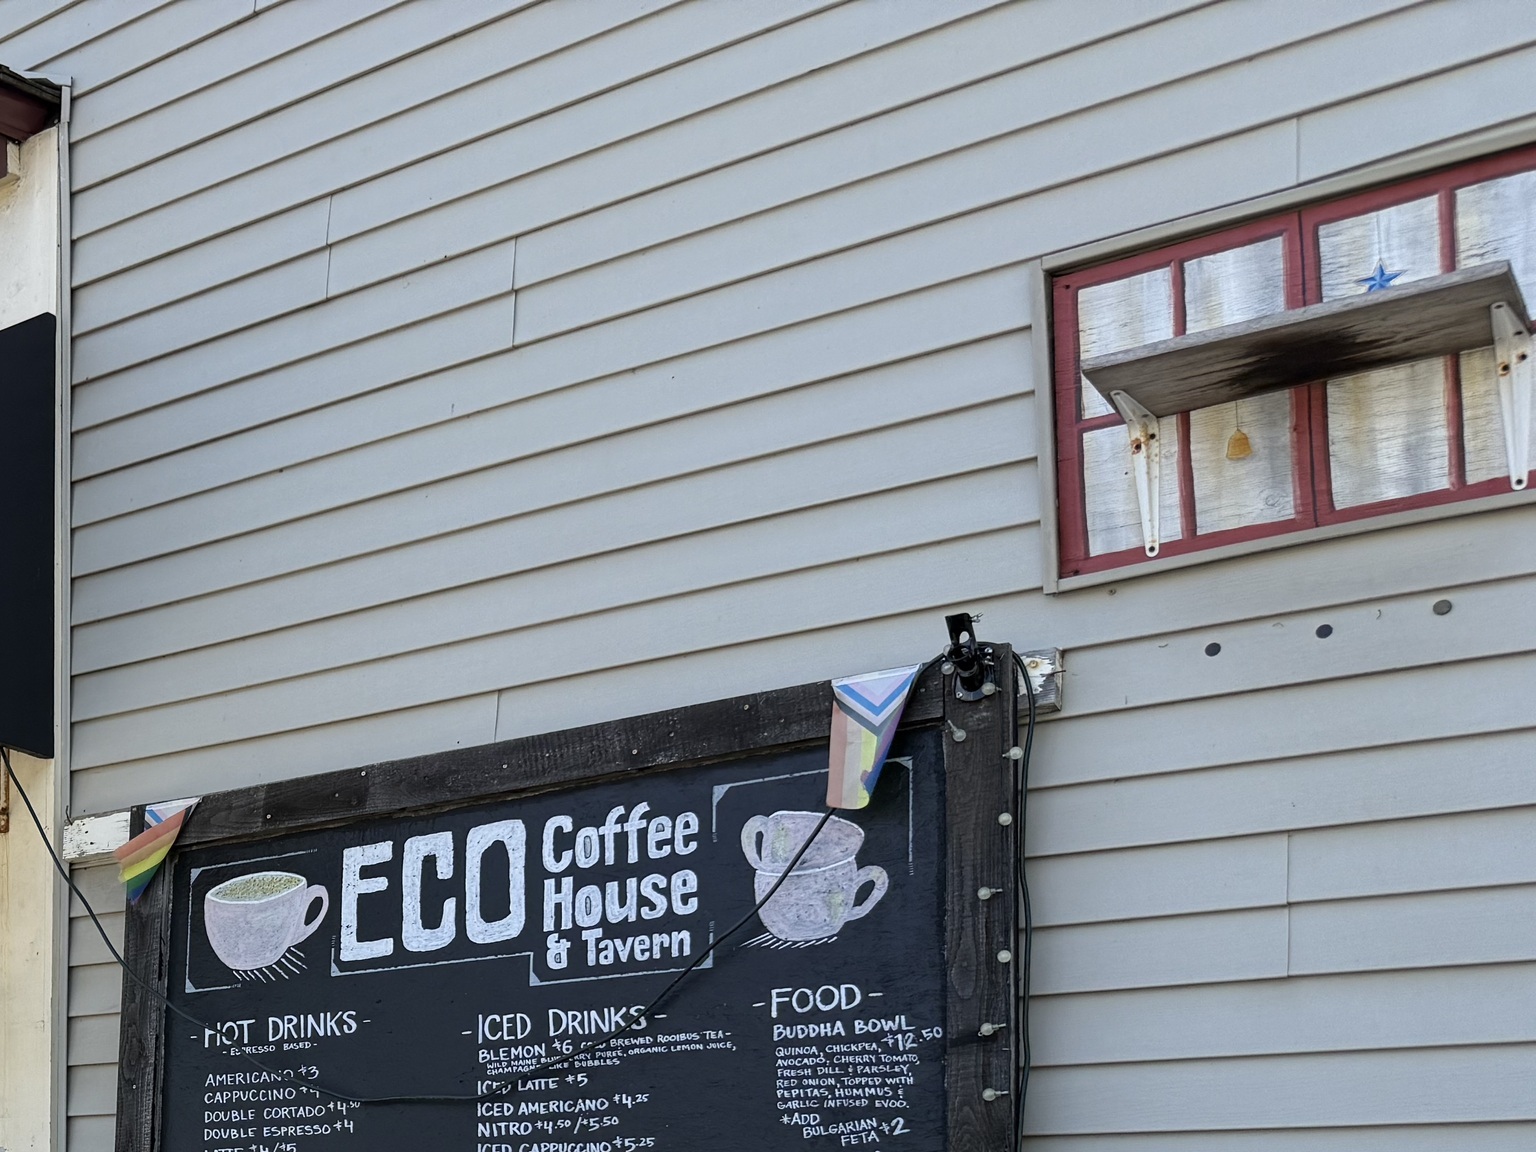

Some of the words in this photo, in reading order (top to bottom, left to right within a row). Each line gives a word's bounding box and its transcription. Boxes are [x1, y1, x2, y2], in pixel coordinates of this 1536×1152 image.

[541, 801, 700, 873] Coffee
[340, 817, 526, 963] ECO
[543, 868, 700, 933] House
[547, 933, 571, 970] &
[582, 926, 691, 964] Tavern
[771, 984, 861, 1018] FOOD
[204, 1019, 255, 1048] HOT
[268, 1010, 357, 1042] DRINKS
[478, 1013, 531, 1043] ICED
[549, 1005, 647, 1037] DRINKS
[773, 1021, 845, 1041] BUDDHA
[855, 1015, 915, 1034] BOWL
[881, 1027, 943, 1051] $12.50
[478, 1043, 545, 1063] BLEMON
[775, 1047, 823, 1057] QUINOA,
[825, 1043, 881, 1054] CHICKPEA,
[833, 1055, 876, 1064] CHERRY
[878, 1054, 919, 1065] TOMATO,
[777, 1068, 811, 1077] FRESH
[818, 1067, 844, 1075] DILL
[857, 1064, 912, 1076] PARSLEY,
[776, 1080, 797, 1089] RED
[802, 1078, 840, 1088] ONION,
[841, 1078, 881, 1086] TOPPED
[885, 1076, 913, 1085] WITH
[777, 1089, 831, 1098] PEPITAS,
[835, 1088, 892, 1097] HUMMUS
[204, 1110, 255, 1123] DOUBLE
[264, 1106, 325, 1119] CORTADO
[478, 1103, 513, 1116] ICED
[518, 1098, 608, 1115] AMERICANO
[613, 1094, 649, 1108] $4.25
[777, 1101, 819, 1110] GARLIC
[824, 1100, 868, 1108] INFUSED
[204, 1128, 256, 1141] DOUBLE
[263, 1125, 330, 1137] ESPRESSO
[803, 1118, 877, 1138] BULGARIAN
[841, 1132, 879, 1146] FETA
